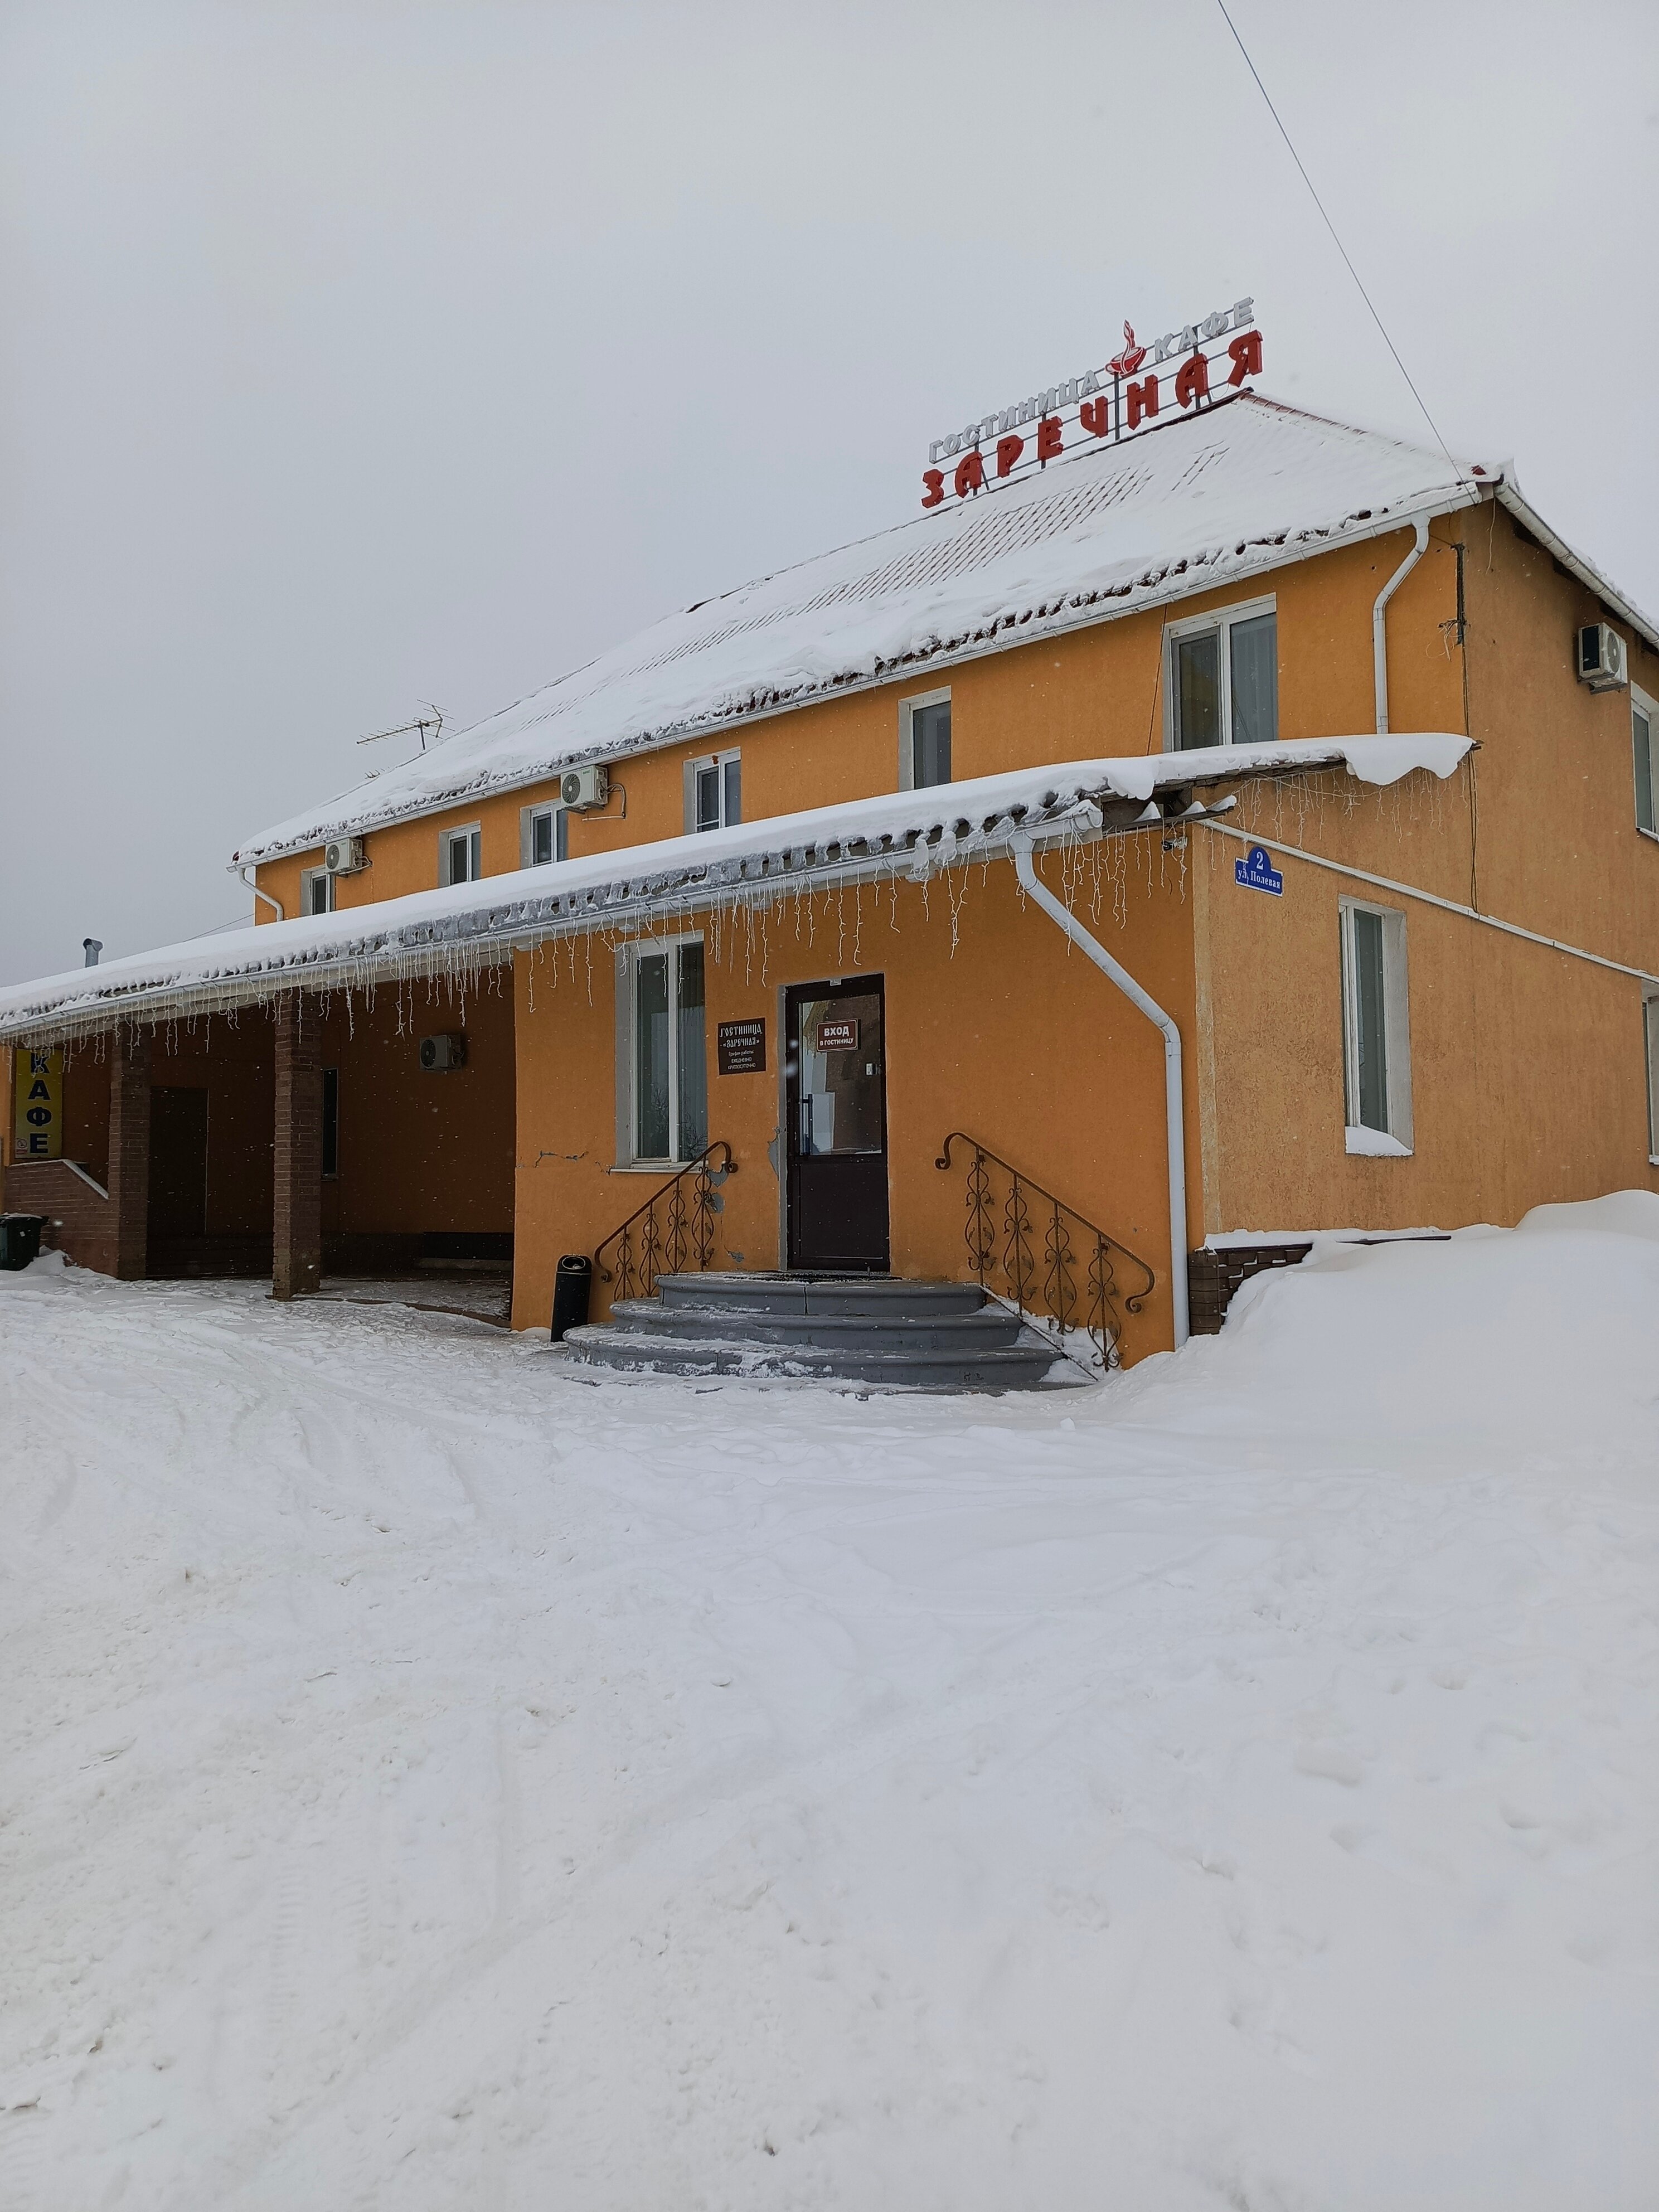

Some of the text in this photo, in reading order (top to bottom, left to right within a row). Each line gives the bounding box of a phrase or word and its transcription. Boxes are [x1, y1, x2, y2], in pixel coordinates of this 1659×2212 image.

[928, 297, 1254, 464] ГОСТИНИЦА КАФЕ
[921, 329, 1264, 508] ЗАРЕЧНАЯ
[1256, 851, 1264, 870] 2
[1250, 871, 1280, 889] Полевая
[719, 1023, 763, 1037] ГОСТИНИЦА
[824, 1026, 850, 1037] ВХОД
[722, 1037, 760, 1048] «ЗАРЕЧНАЯ»
[824, 1037, 854, 1046] ГОСТИНИЦУ
[27, 1051, 52, 1153] КАФЕ
